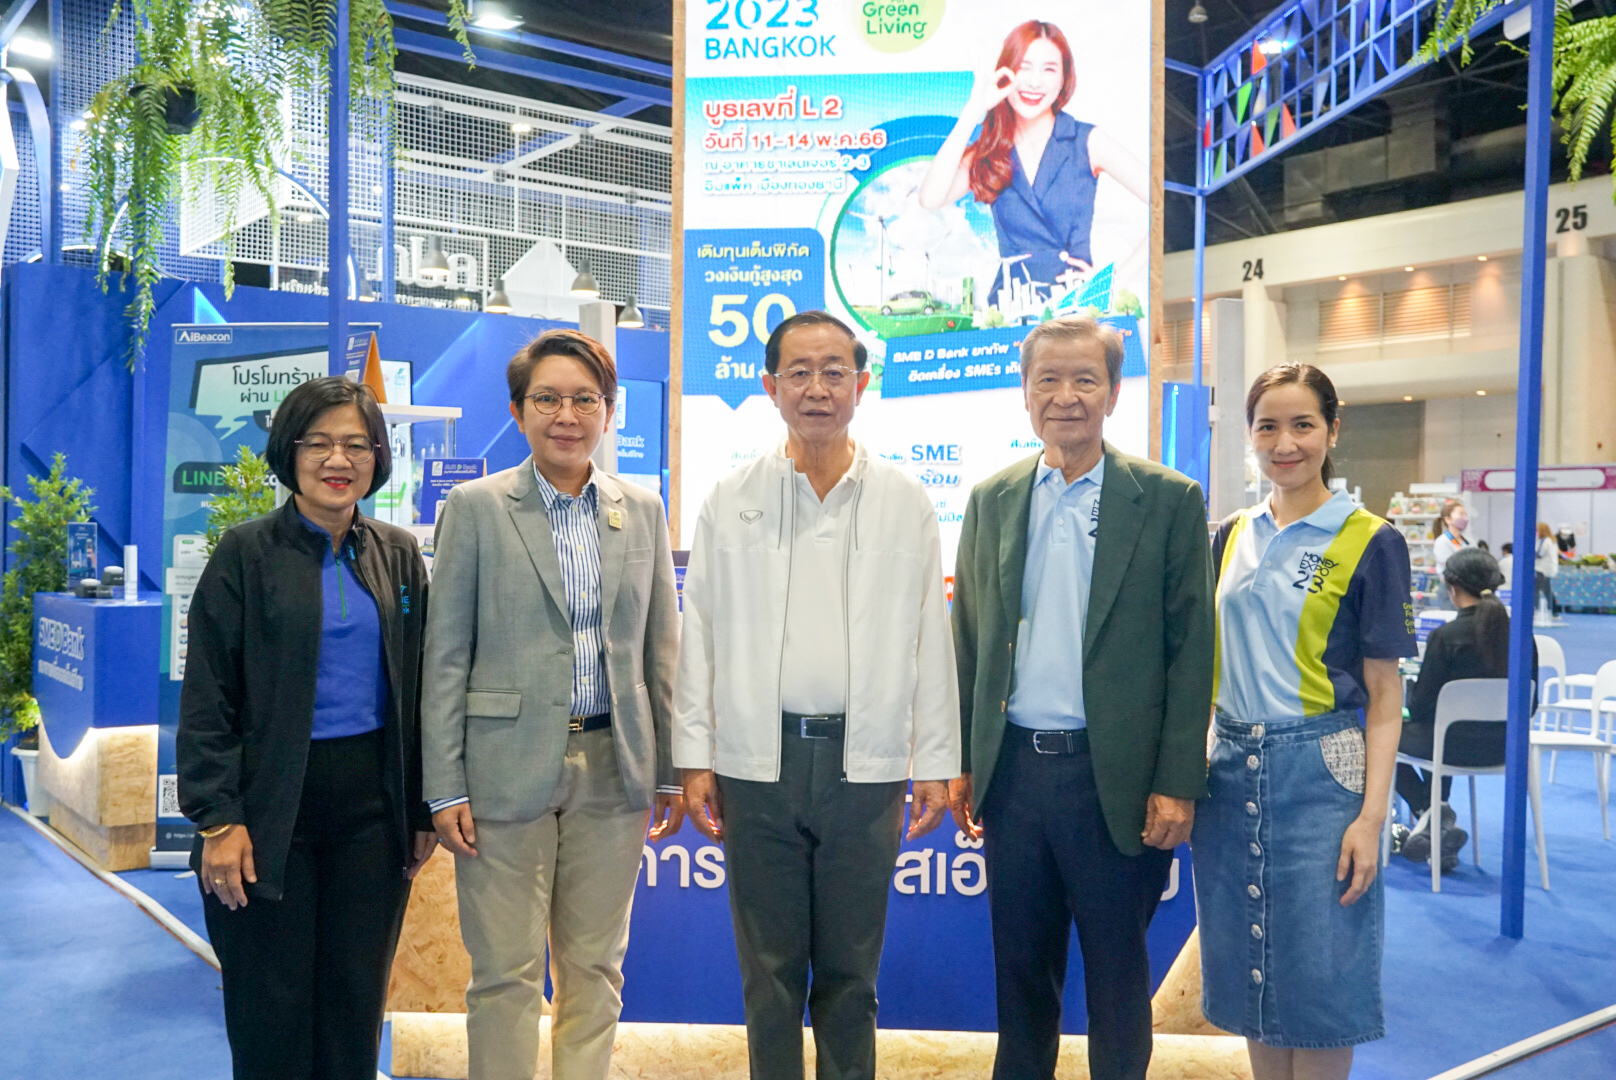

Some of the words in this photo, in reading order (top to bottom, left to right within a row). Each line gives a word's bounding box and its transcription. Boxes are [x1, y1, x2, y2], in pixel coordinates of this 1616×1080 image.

[705, 0, 819, 30] 2023
[862, 1, 919, 17] Green
[866, 18, 927, 39] Living
[705, 35, 836, 60] BANGKOK
[803, 99, 817, 116] L
[825, 98, 839, 116] 2
[705, 127, 744, 149] วันที่
[1556, 204, 1588, 234] 25
[704, 264, 803, 287] วงเงินกู้สูงสุด
[1243, 258, 1264, 282] 24
[707, 293, 798, 348] 50
[178, 330, 231, 342] AiBeacon
[893, 351, 922, 363] SME
[923, 349, 935, 360] D
[937, 347, 969, 359] Bank
[714, 355, 755, 379] ล้าน
[964, 363, 1001, 377] SMEs
[240, 389, 269, 403] ผ่าน
[911, 444, 959, 461] SME
[182, 470, 225, 486] LINE
[1299, 559, 1330, 577] EXPO
[1302, 551, 1339, 569] MONEY
[1292, 570, 1325, 594] 23
